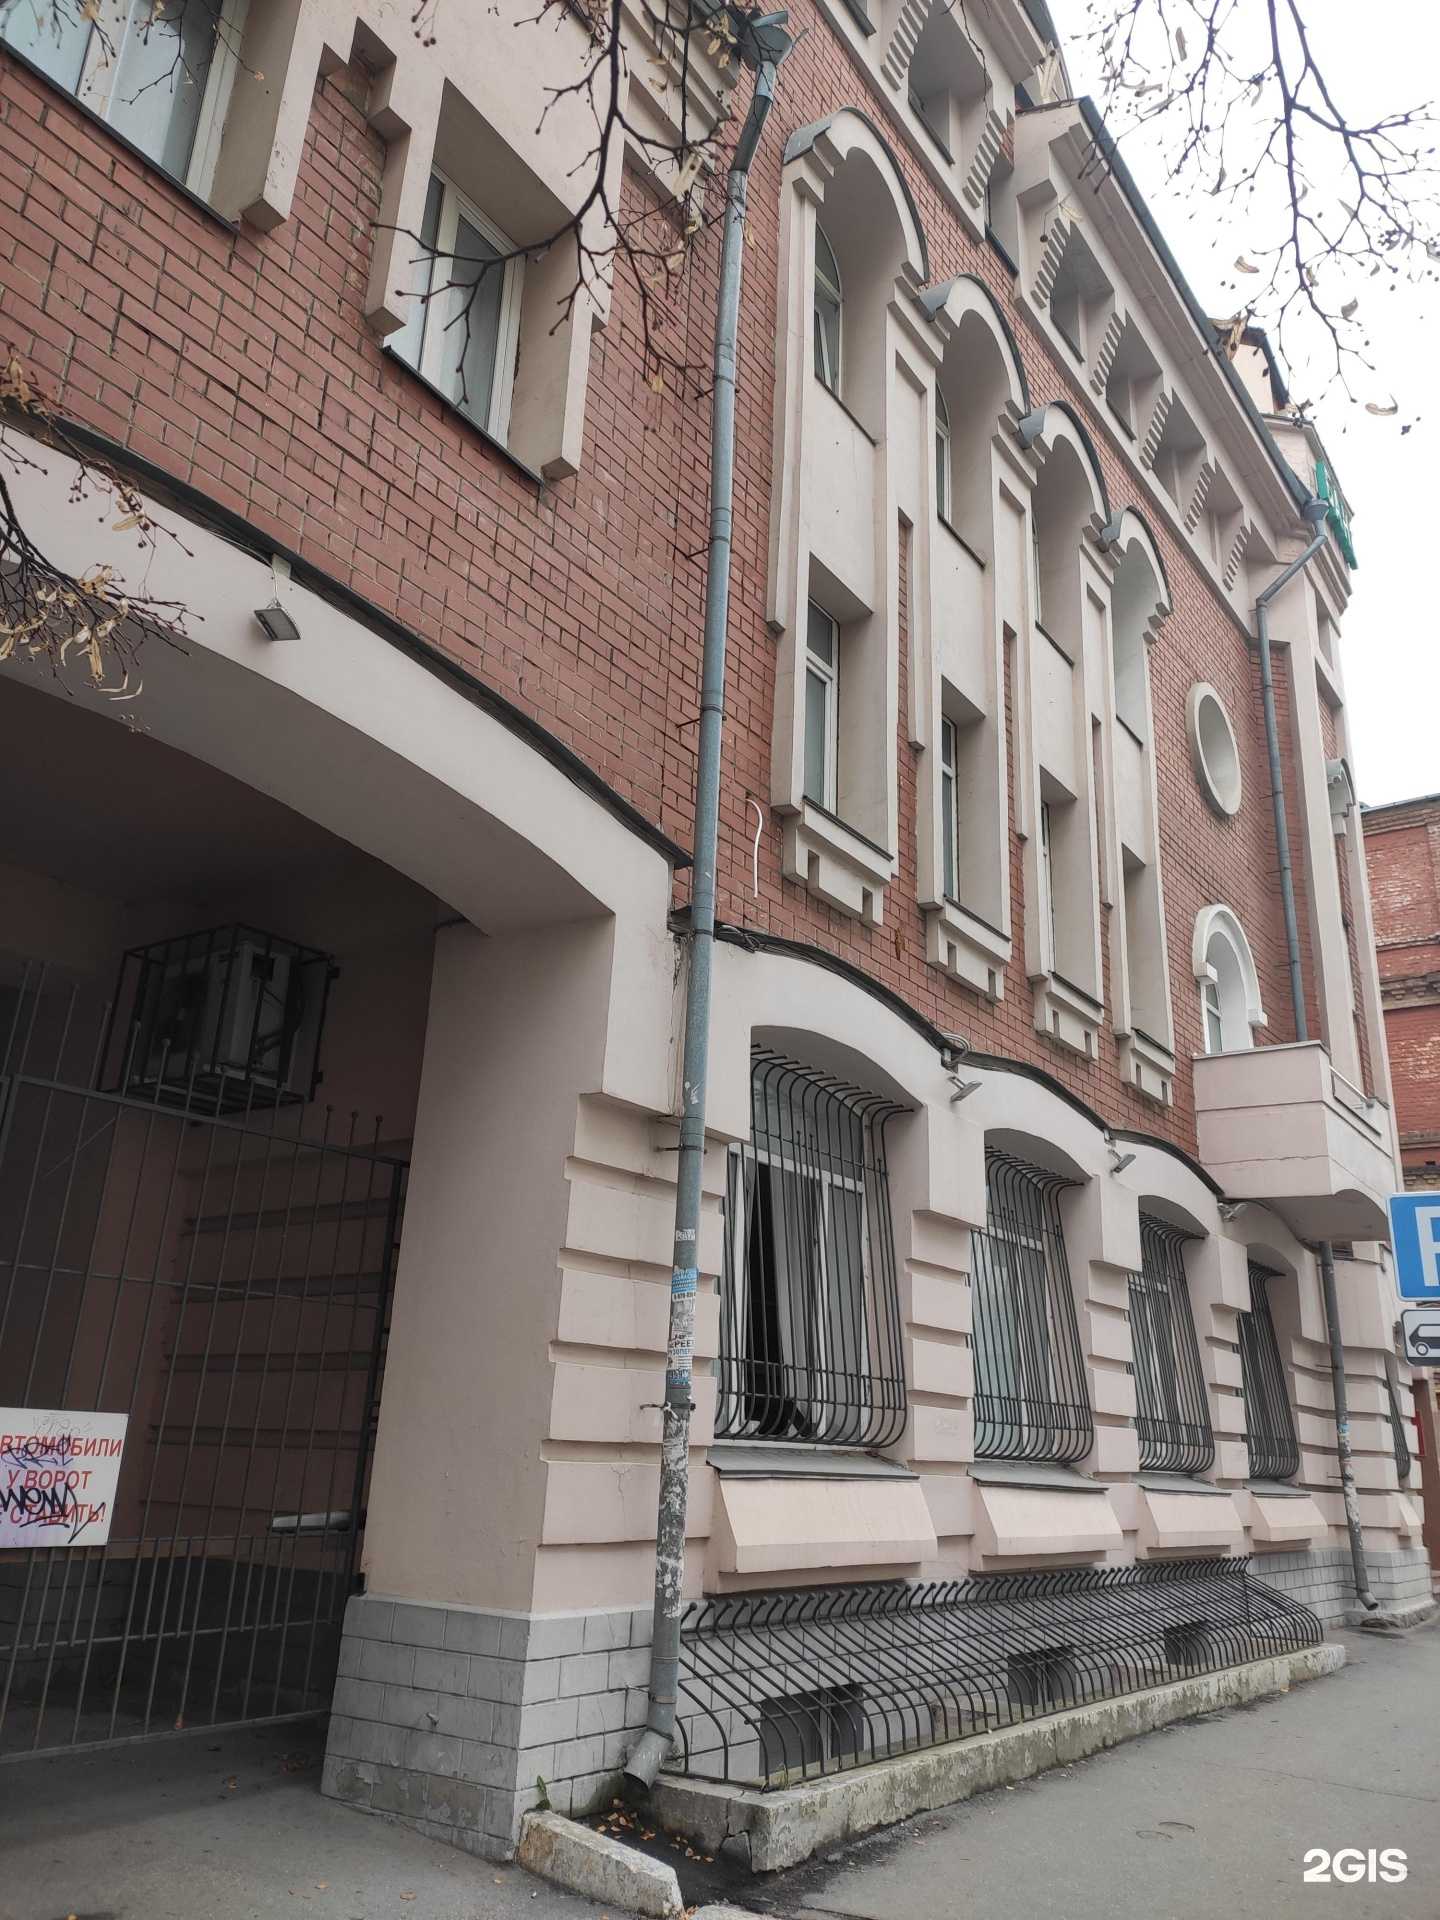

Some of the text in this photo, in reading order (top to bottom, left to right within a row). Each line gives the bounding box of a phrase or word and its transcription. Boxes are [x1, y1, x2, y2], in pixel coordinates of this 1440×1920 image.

[0, 1435, 123, 1457] ВТОМОБИЛИ
[7, 1469, 93, 1490] У ВОРОТ
